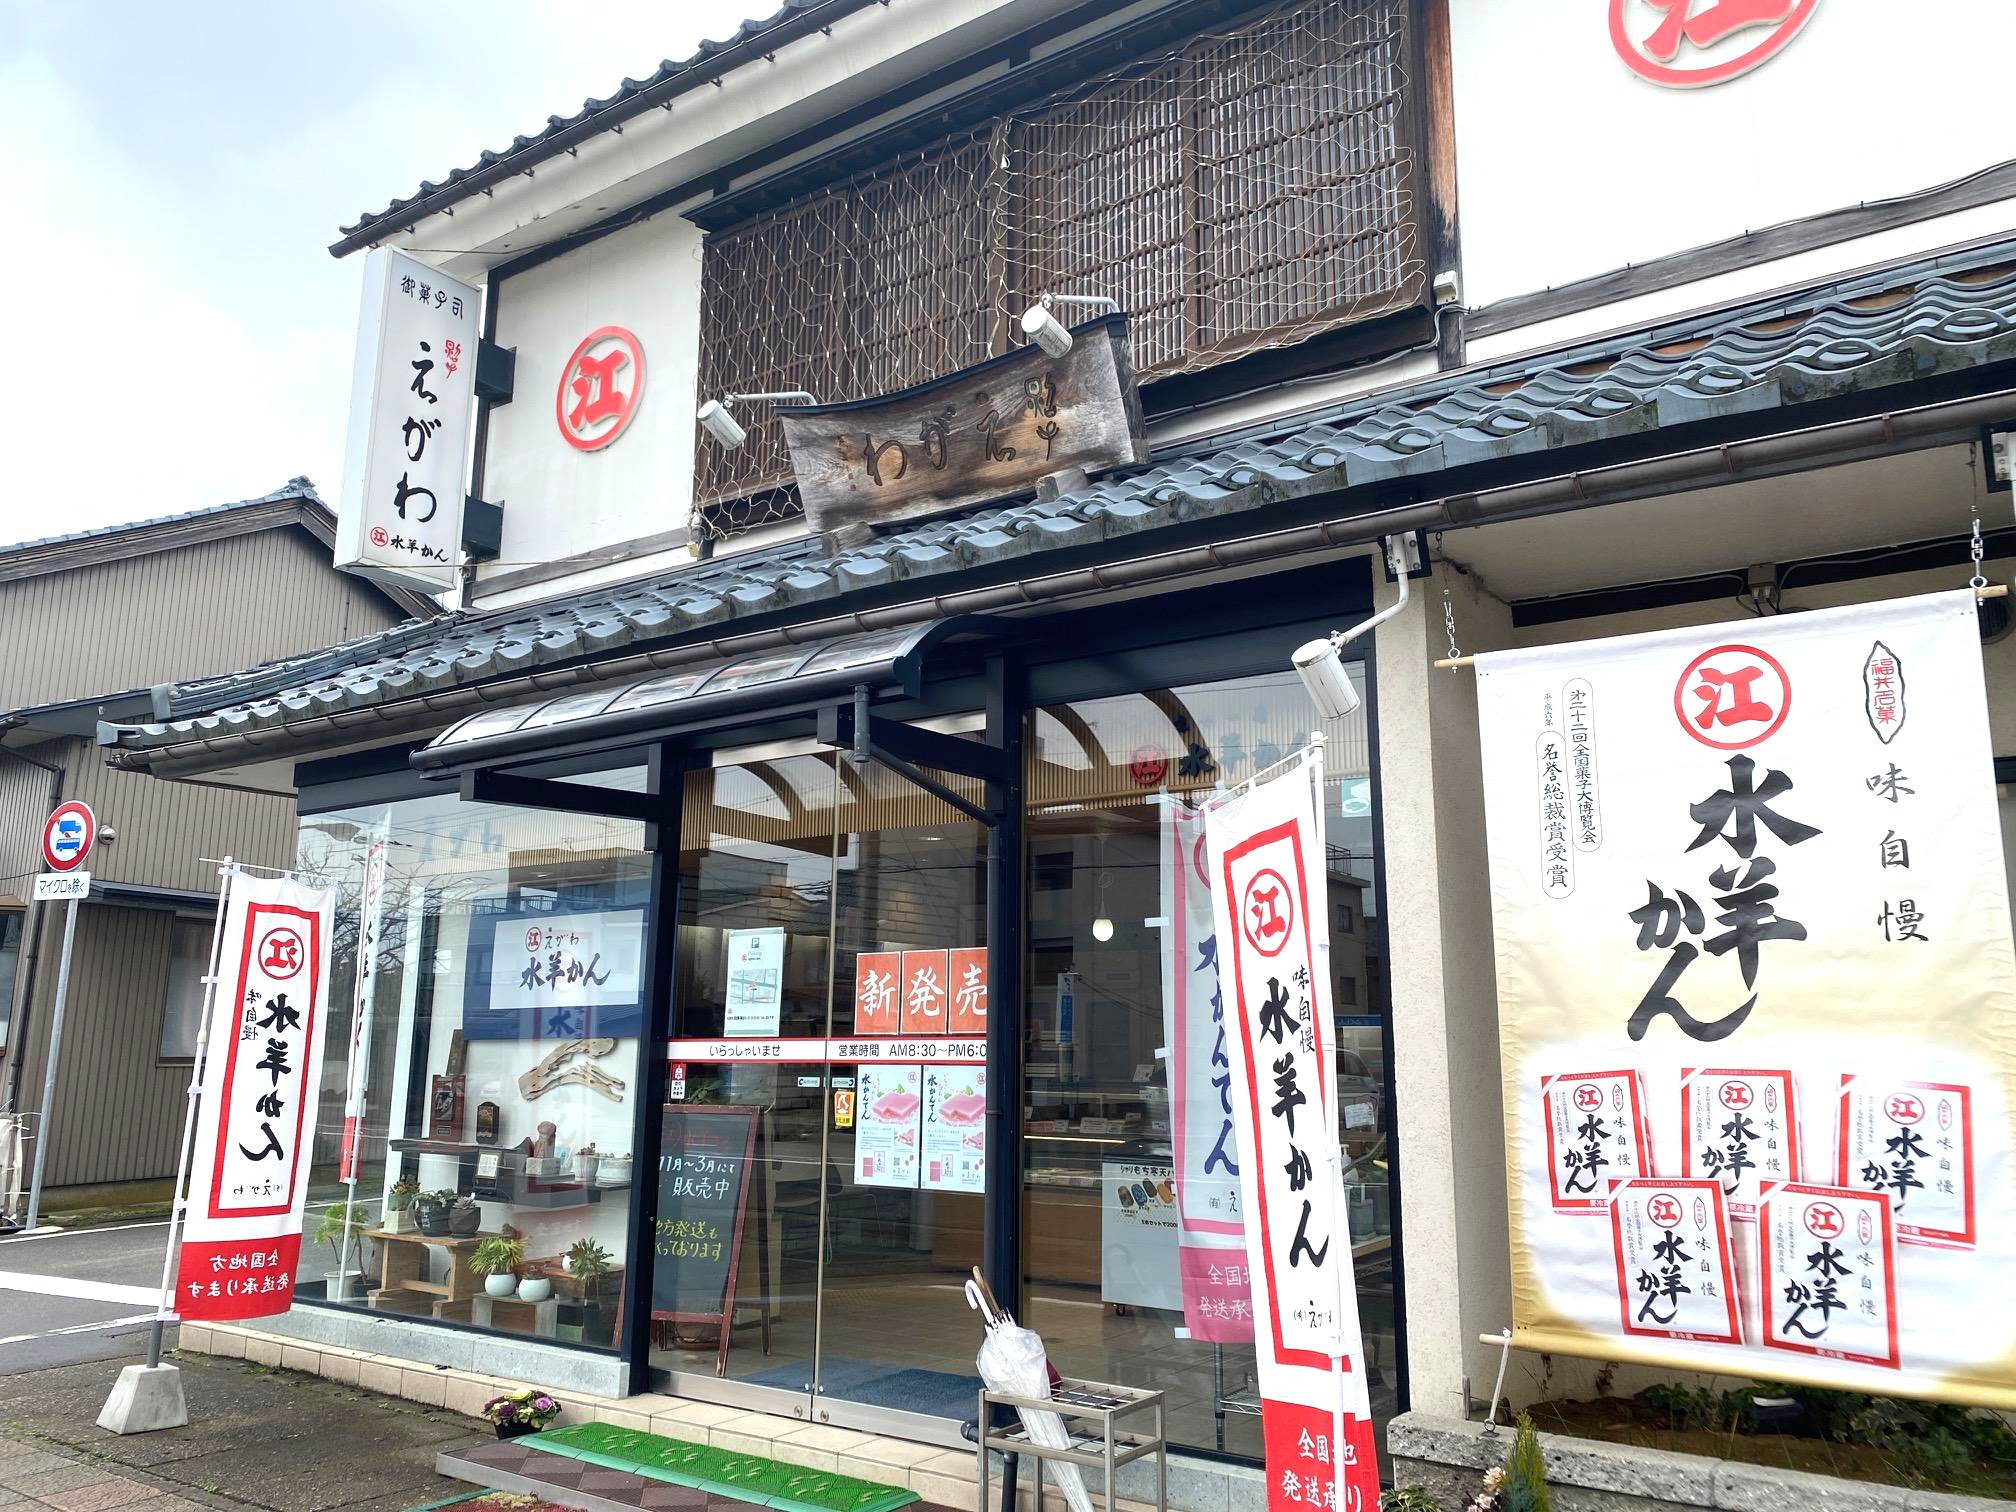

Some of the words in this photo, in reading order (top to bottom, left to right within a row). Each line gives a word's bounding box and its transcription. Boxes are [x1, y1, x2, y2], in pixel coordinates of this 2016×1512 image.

[401, 275, 463, 321] 御菓子司
[393, 341, 442, 523] えがわ
[390, 534, 449, 563] 水羊かん
[1542, 743, 1569, 888] 名誉総裁賞受賞
[1865, 763, 1930, 943] 味自慢
[40, 878, 85, 895] マイクロを除く
[519, 950, 612, 993] 水羊かん
[858, 963, 987, 1020] 新発売
[1291, 964, 1316, 1054] 味自慢
[709, 1044, 781, 1057] いらっしゃいませ
[838, 1043, 880, 1057] 営業時間
[861, 1073, 872, 1120] 水かんてん
[926, 1074, 938, 1123] 水かんてん
[1259, 976, 1329, 1268] 水羊かん
[671, 1176, 730, 1200] 販売中
